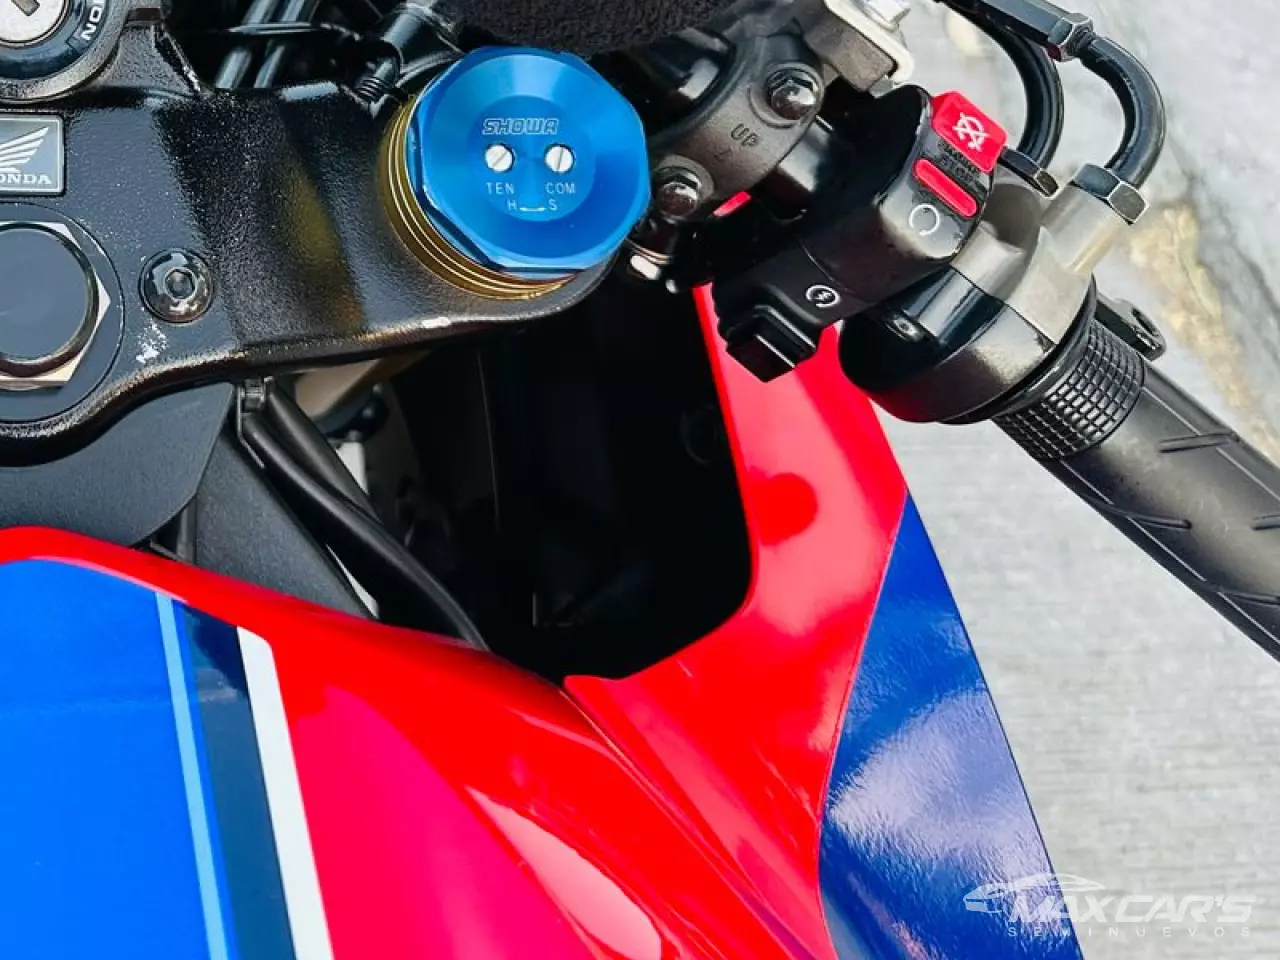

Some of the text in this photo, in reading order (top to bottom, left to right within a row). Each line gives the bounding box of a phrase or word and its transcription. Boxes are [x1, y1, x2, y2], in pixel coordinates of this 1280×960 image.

[482, 117, 560, 135] SHOWA
[730, 122, 761, 147] UP
[486, 182, 576, 195] TEN COM
[507, 199, 558, 211] H S
